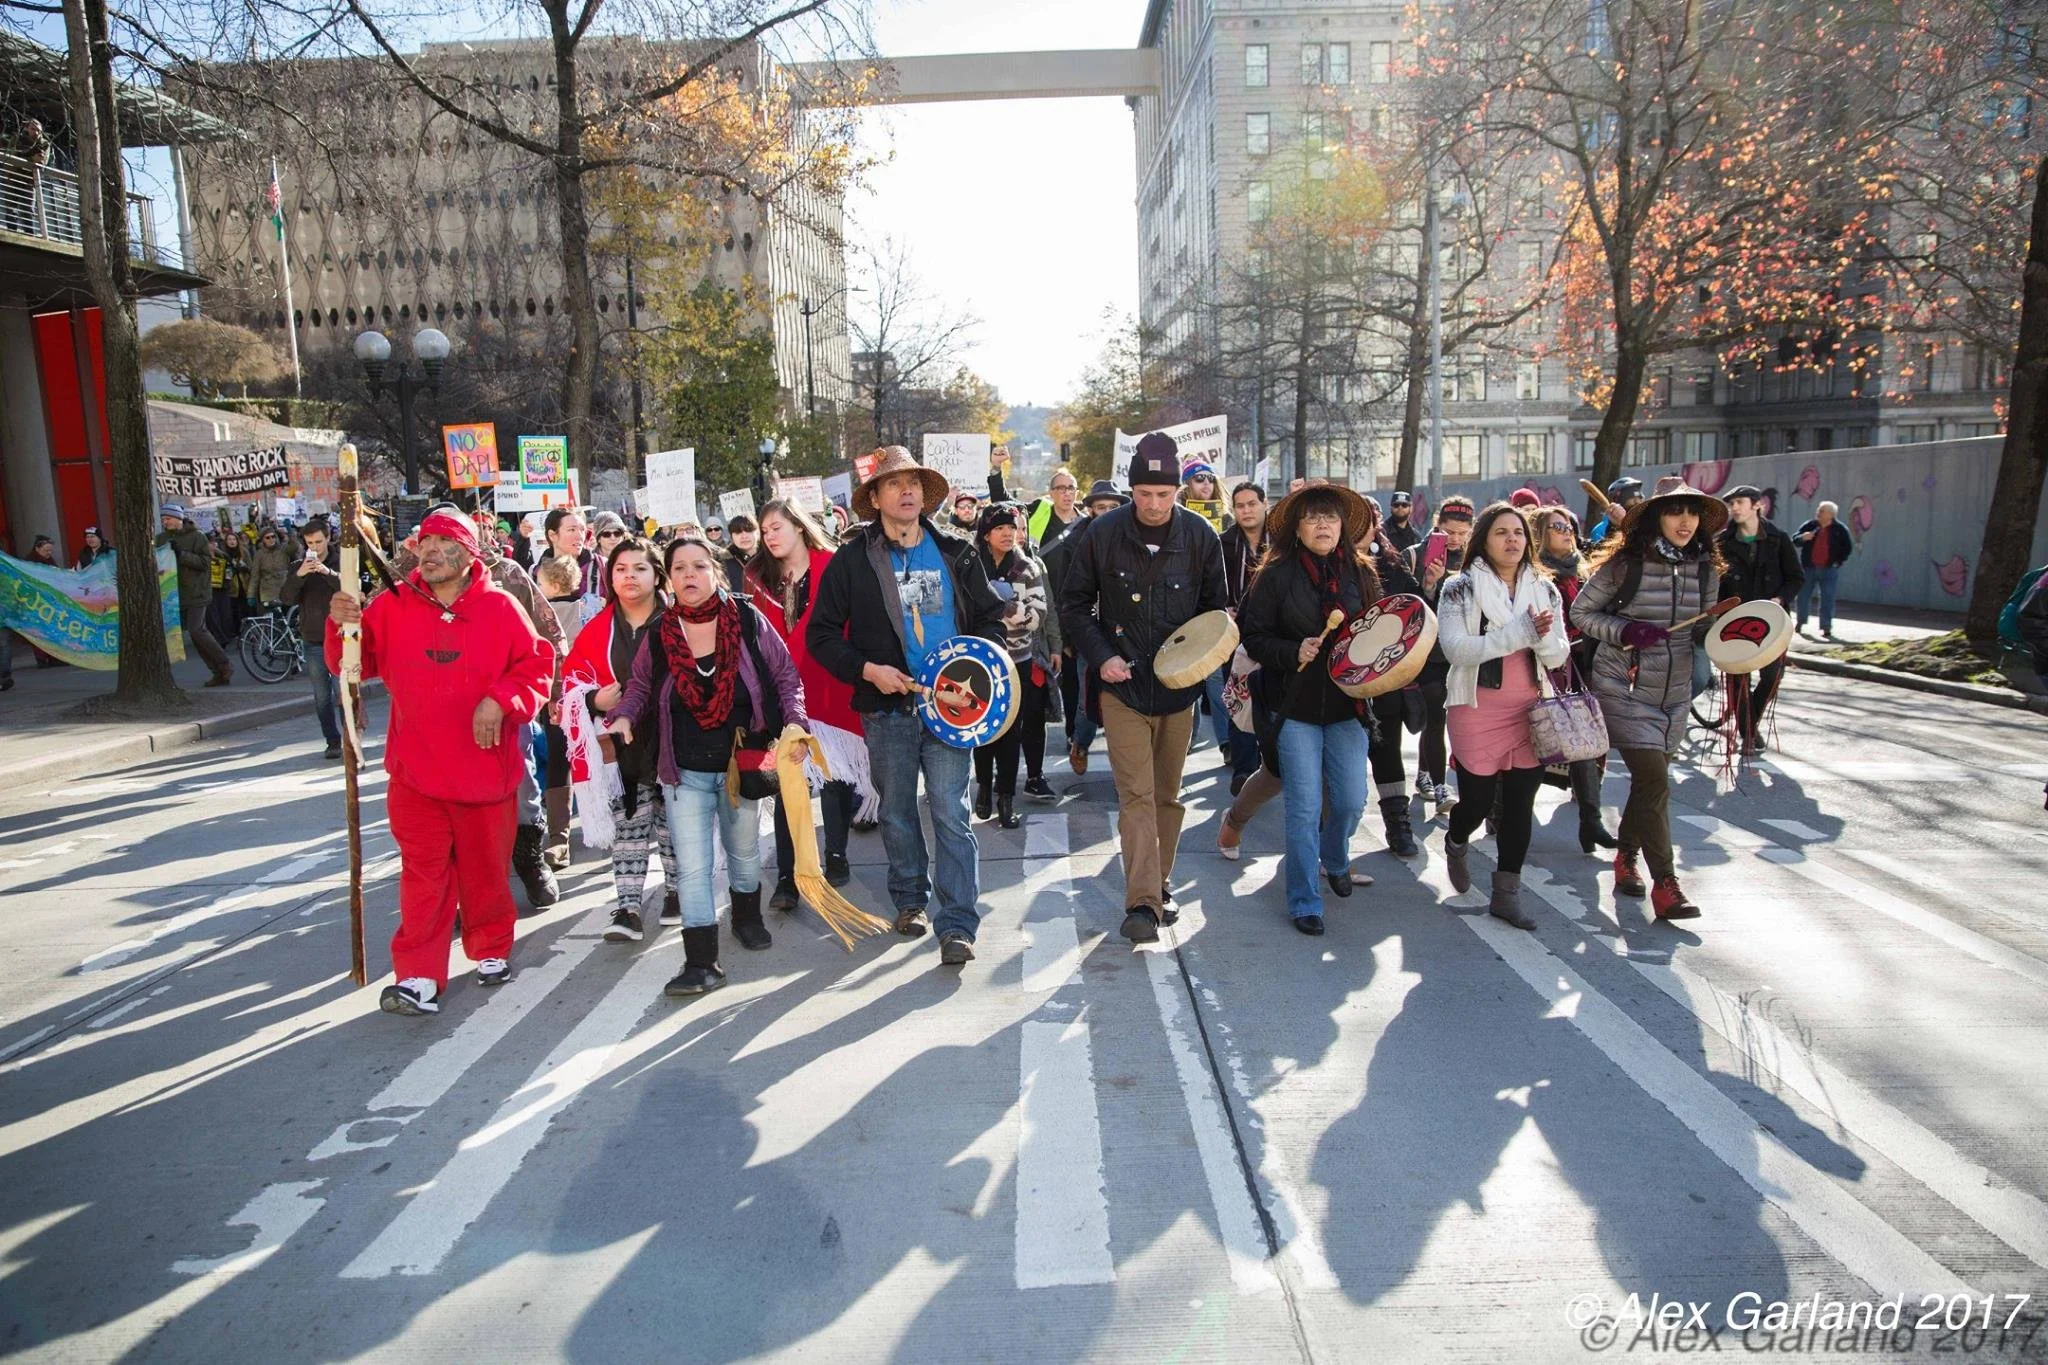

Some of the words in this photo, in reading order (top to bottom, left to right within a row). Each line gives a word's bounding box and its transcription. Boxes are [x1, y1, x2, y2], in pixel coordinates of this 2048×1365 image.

[448, 433, 475, 452] NO
[192, 455, 247, 477] STANDING
[248, 447, 285, 472] ROCK
[453, 454, 496, 476] DAPL
[180, 477, 193, 497] IS
[194, 478, 218, 497] LIFE
[219, 476, 262, 495] #DEFUND
[263, 470, 289, 486] DAPL
